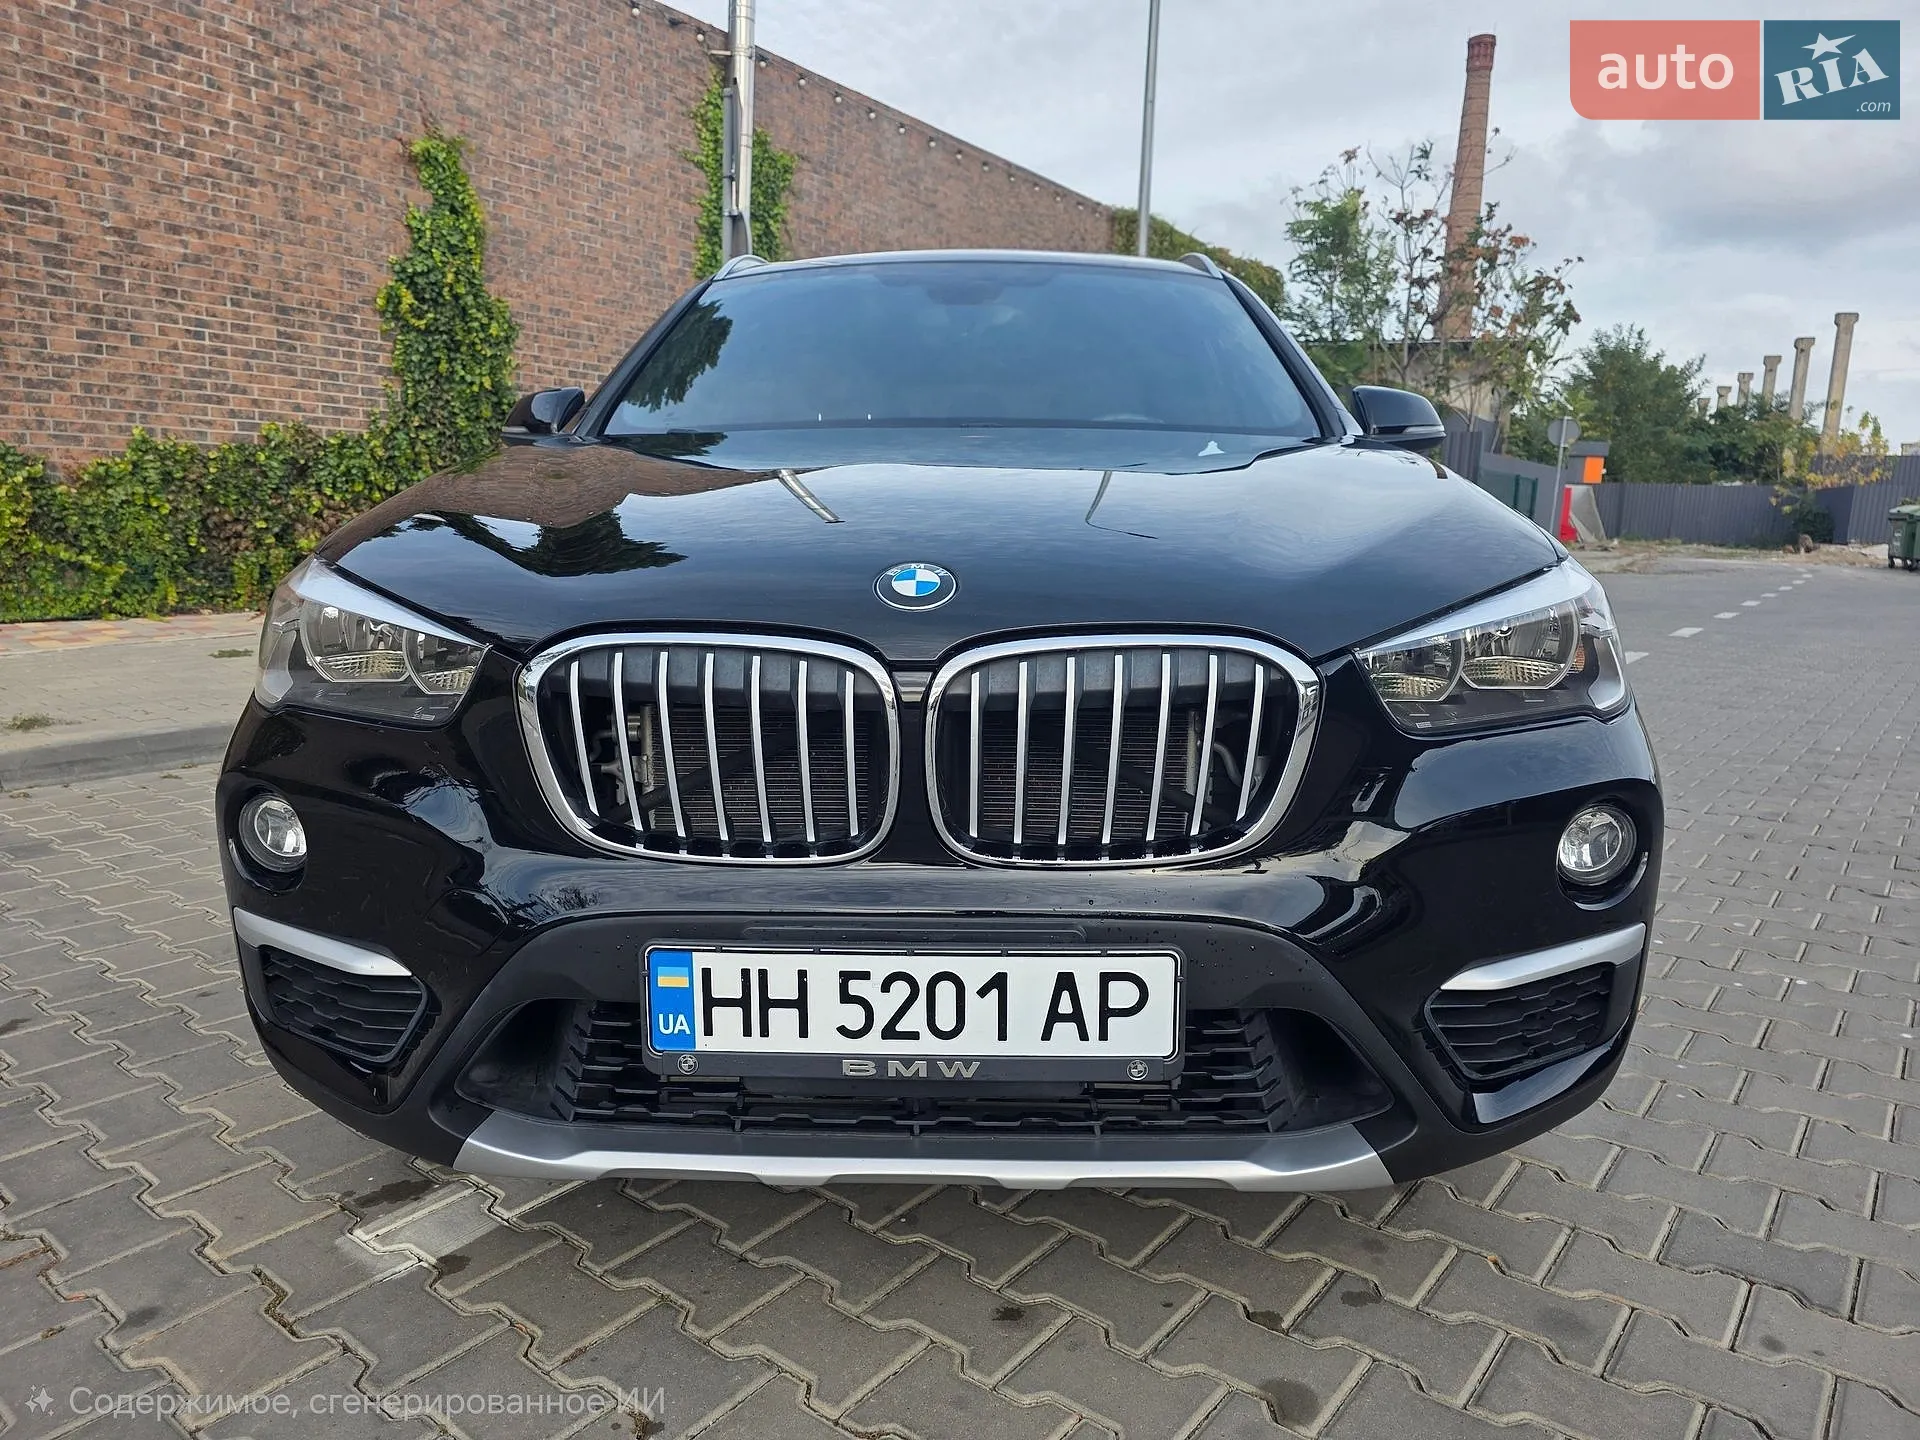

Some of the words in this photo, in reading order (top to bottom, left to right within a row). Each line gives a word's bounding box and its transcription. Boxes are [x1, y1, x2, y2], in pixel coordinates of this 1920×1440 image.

[702, 967, 808, 1038] HH
[836, 970, 1008, 1041] 5201
[1040, 971, 1149, 1042] AP
[658, 1013, 691, 1035] UA
[842, 1059, 981, 1079] BMW
